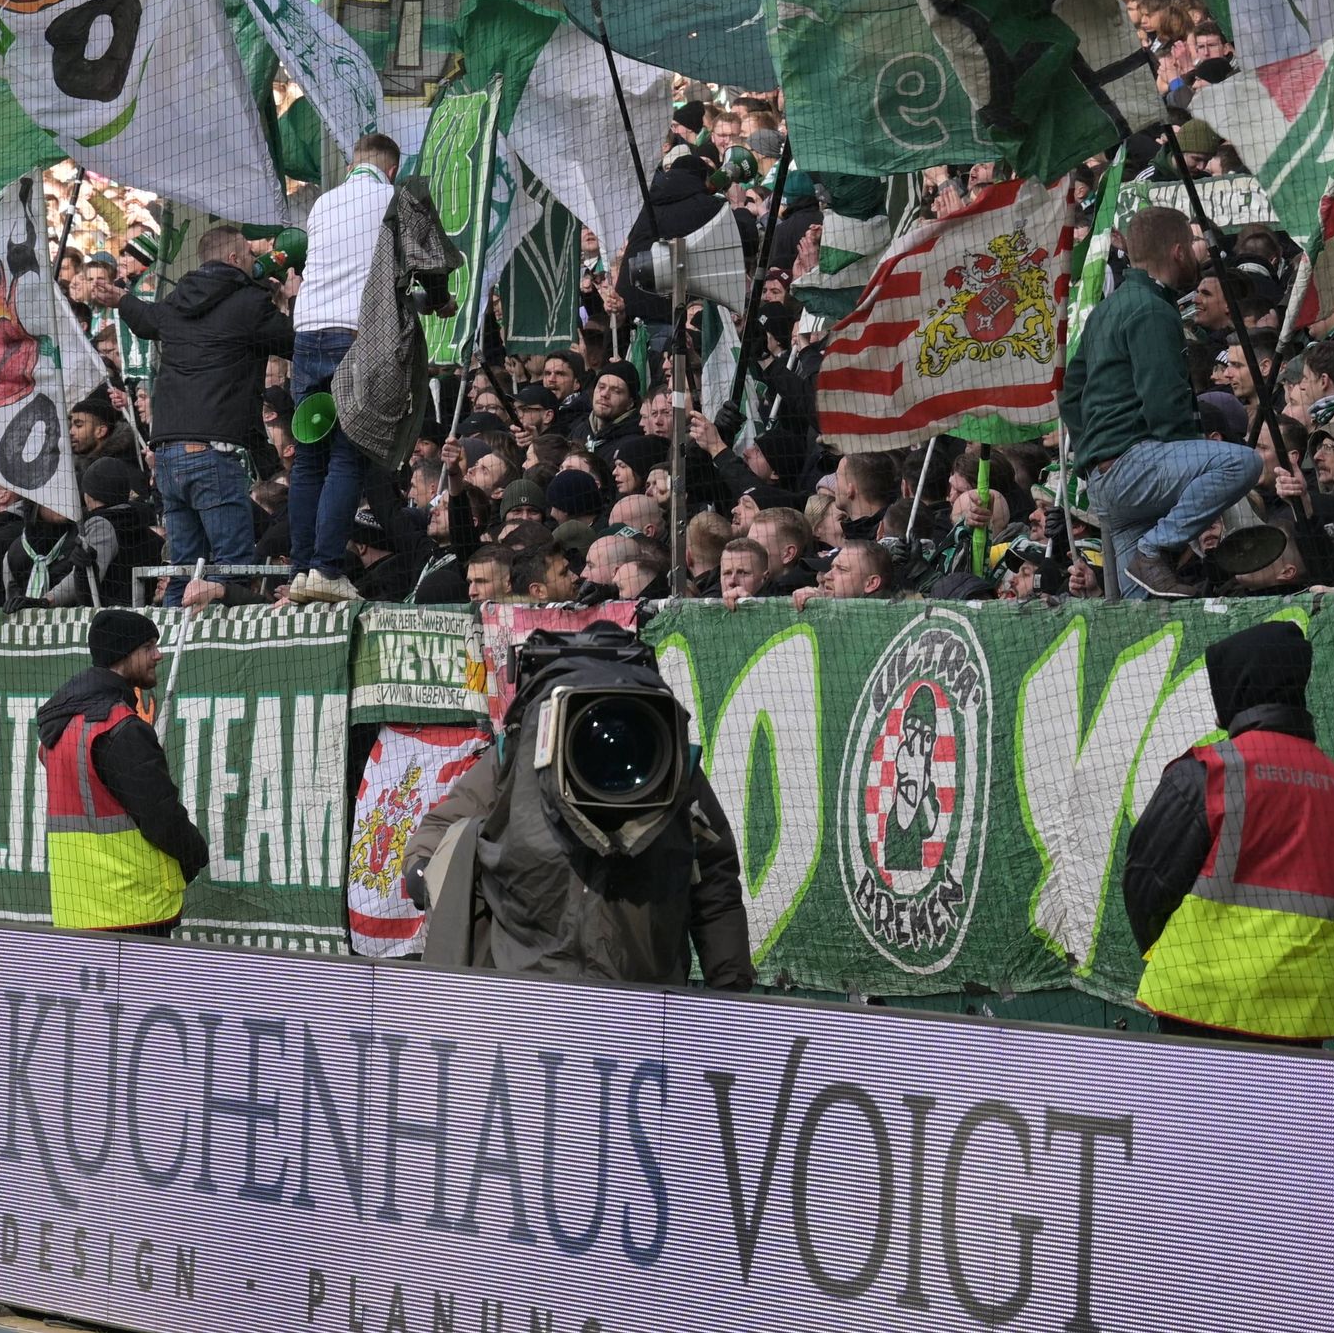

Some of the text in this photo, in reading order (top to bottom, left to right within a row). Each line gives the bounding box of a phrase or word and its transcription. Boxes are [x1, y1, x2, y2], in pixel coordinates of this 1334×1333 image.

[377, 634, 467, 683] WEYHE
[175, 693, 348, 888] TEAM
[854, 860, 965, 952] BREMEN
[4, 966, 667, 1267] KÜCHENHAUS
[703, 1035, 1135, 1333] VOIGT
[1, 1212, 196, 1300] DESIGN
